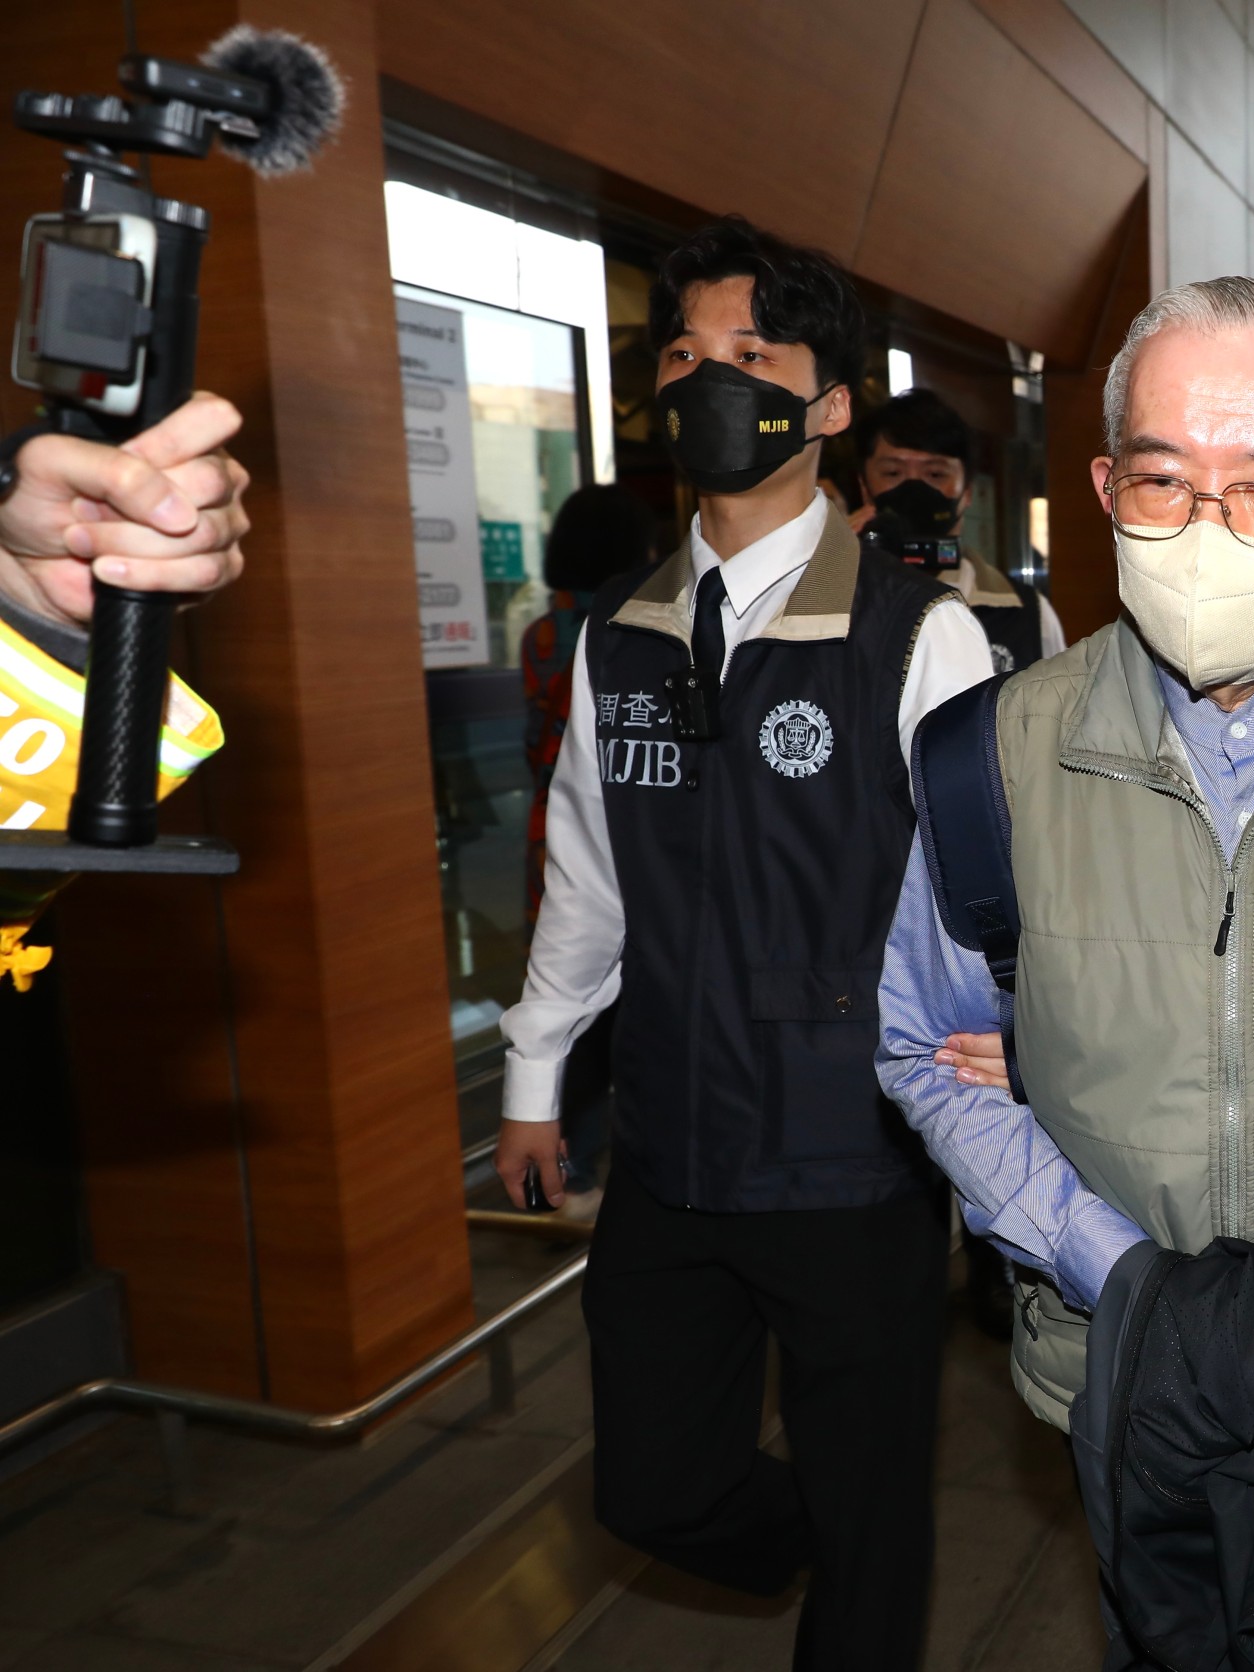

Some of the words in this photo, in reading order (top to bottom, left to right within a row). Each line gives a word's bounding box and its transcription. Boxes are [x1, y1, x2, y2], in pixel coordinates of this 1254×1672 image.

[758, 419, 790, 433] MJIB
[597, 690, 672, 728] 調查
[597, 738, 682, 787] MJIB
